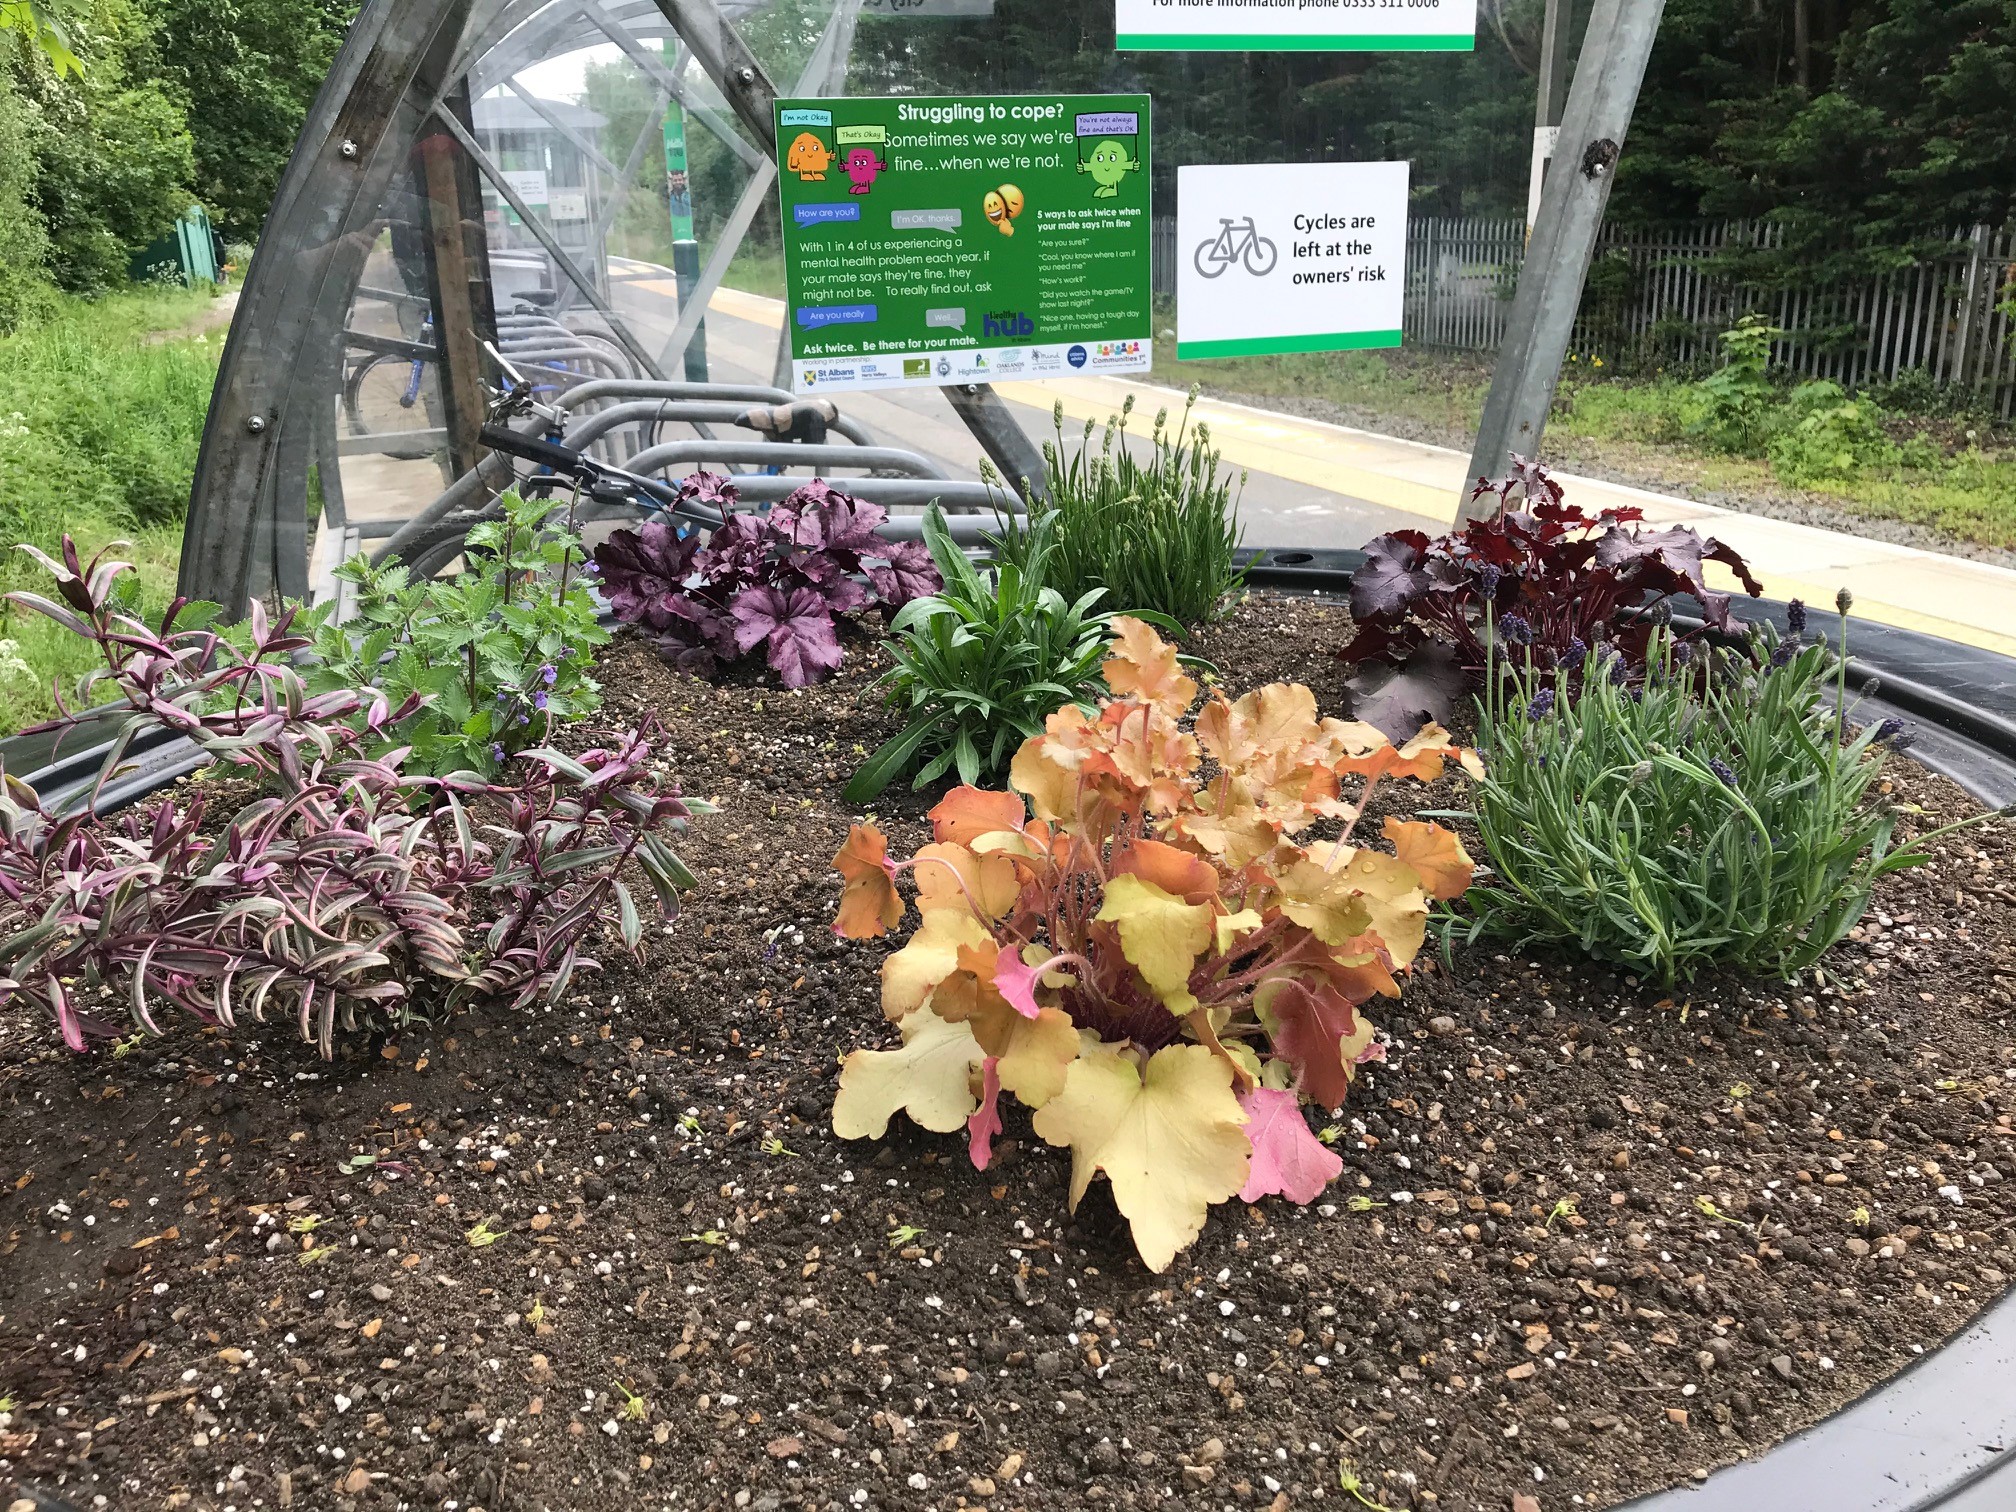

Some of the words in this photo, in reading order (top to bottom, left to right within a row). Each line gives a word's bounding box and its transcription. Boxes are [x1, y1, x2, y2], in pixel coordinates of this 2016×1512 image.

[810, 113, 828, 122] Okay
[898, 103, 985, 123] Struggling
[989, 103, 1006, 119] to
[1011, 103, 1064, 122] cope?
[1112, 116, 1132, 124] always
[864, 130, 881, 139] Okay
[884, 131, 969, 148] Sometimes
[973, 134, 997, 146] we
[1000, 133, 1027, 149] say
[1030, 130, 1074, 144] we're
[986, 154, 1031, 168] we're
[1035, 153, 1064, 168] not.
[798, 209, 817, 218] How
[835, 208, 855, 218] you?
[896, 215, 910, 223] I'm
[1037, 210, 1042, 219] 5
[1044, 210, 1066, 220] ways
[1068, 209, 1076, 218] to
[1078, 208, 1092, 217] ask
[1094, 207, 1117, 217] twice
[1119, 207, 1141, 216] when
[1037, 222, 1056, 232] your
[1058, 220, 1080, 230] mate
[1082, 220, 1101, 230] says
[1102, 219, 1115, 228] I'm
[1116, 218, 1131, 228] fine
[1294, 213, 1346, 234] Cycles
[1351, 216, 1375, 228] are
[800, 242, 823, 252] With
[827, 242, 831, 252] 1
[835, 241, 845, 251] in
[847, 241, 854, 251] 4
[857, 240, 868, 250] of
[870, 242, 882, 250] us
[884, 238, 952, 251] experiencing
[955, 239, 963, 247] a
[1055, 240, 1067, 248] you
[1293, 241, 1321, 257] left
[1326, 242, 1341, 256] at
[1346, 239, 1372, 255] the
[801, 257, 839, 268] mental
[842, 256, 876, 267] health
[878, 255, 923, 268] problem
[925, 252, 951, 265] each
[984, 251, 990, 261] if
[1075, 251, 1093, 259] know
[1094, 250, 1114, 259] where
[1052, 262, 1070, 271] need
[802, 275, 825, 286] your
[828, 272, 857, 283] mate
[859, 272, 882, 284] says
[884, 270, 921, 283] they're
[949, 267, 971, 280] they
[1292, 266, 1354, 285] owners'
[1358, 264, 1386, 281] risk
[803, 288, 834, 301] might
[836, 288, 854, 299] not
[857, 287, 875, 298] be.
[886, 286, 898, 296] To
[900, 284, 929, 298] really
[931, 283, 950, 294] find
[975, 281, 992, 293] ask
[1069, 288, 1090, 297] watch
[1092, 288, 1102, 296] the
[1039, 300, 1056, 309] show
[1058, 299, 1069, 308] last
[810, 312, 824, 320] Are
[826, 312, 842, 321] you
[843, 309, 865, 320] really
[1076, 312, 1098, 321] having
[1106, 310, 1125, 320] tough
[1127, 309, 1140, 318] day
[983, 312, 1035, 337] hub
[803, 344, 823, 355] Ask
[825, 342, 857, 353] twice.
[862, 341, 876, 351] Be
[879, 339, 905, 350] there
[908, 338, 923, 348] for
[924, 337, 946, 350] your
[949, 335, 979, 347] mate.
[802, 358, 828, 366] Working
[818, 369, 826, 377] St
[828, 368, 855, 376] Albans
[958, 367, 990, 376] Hightown
